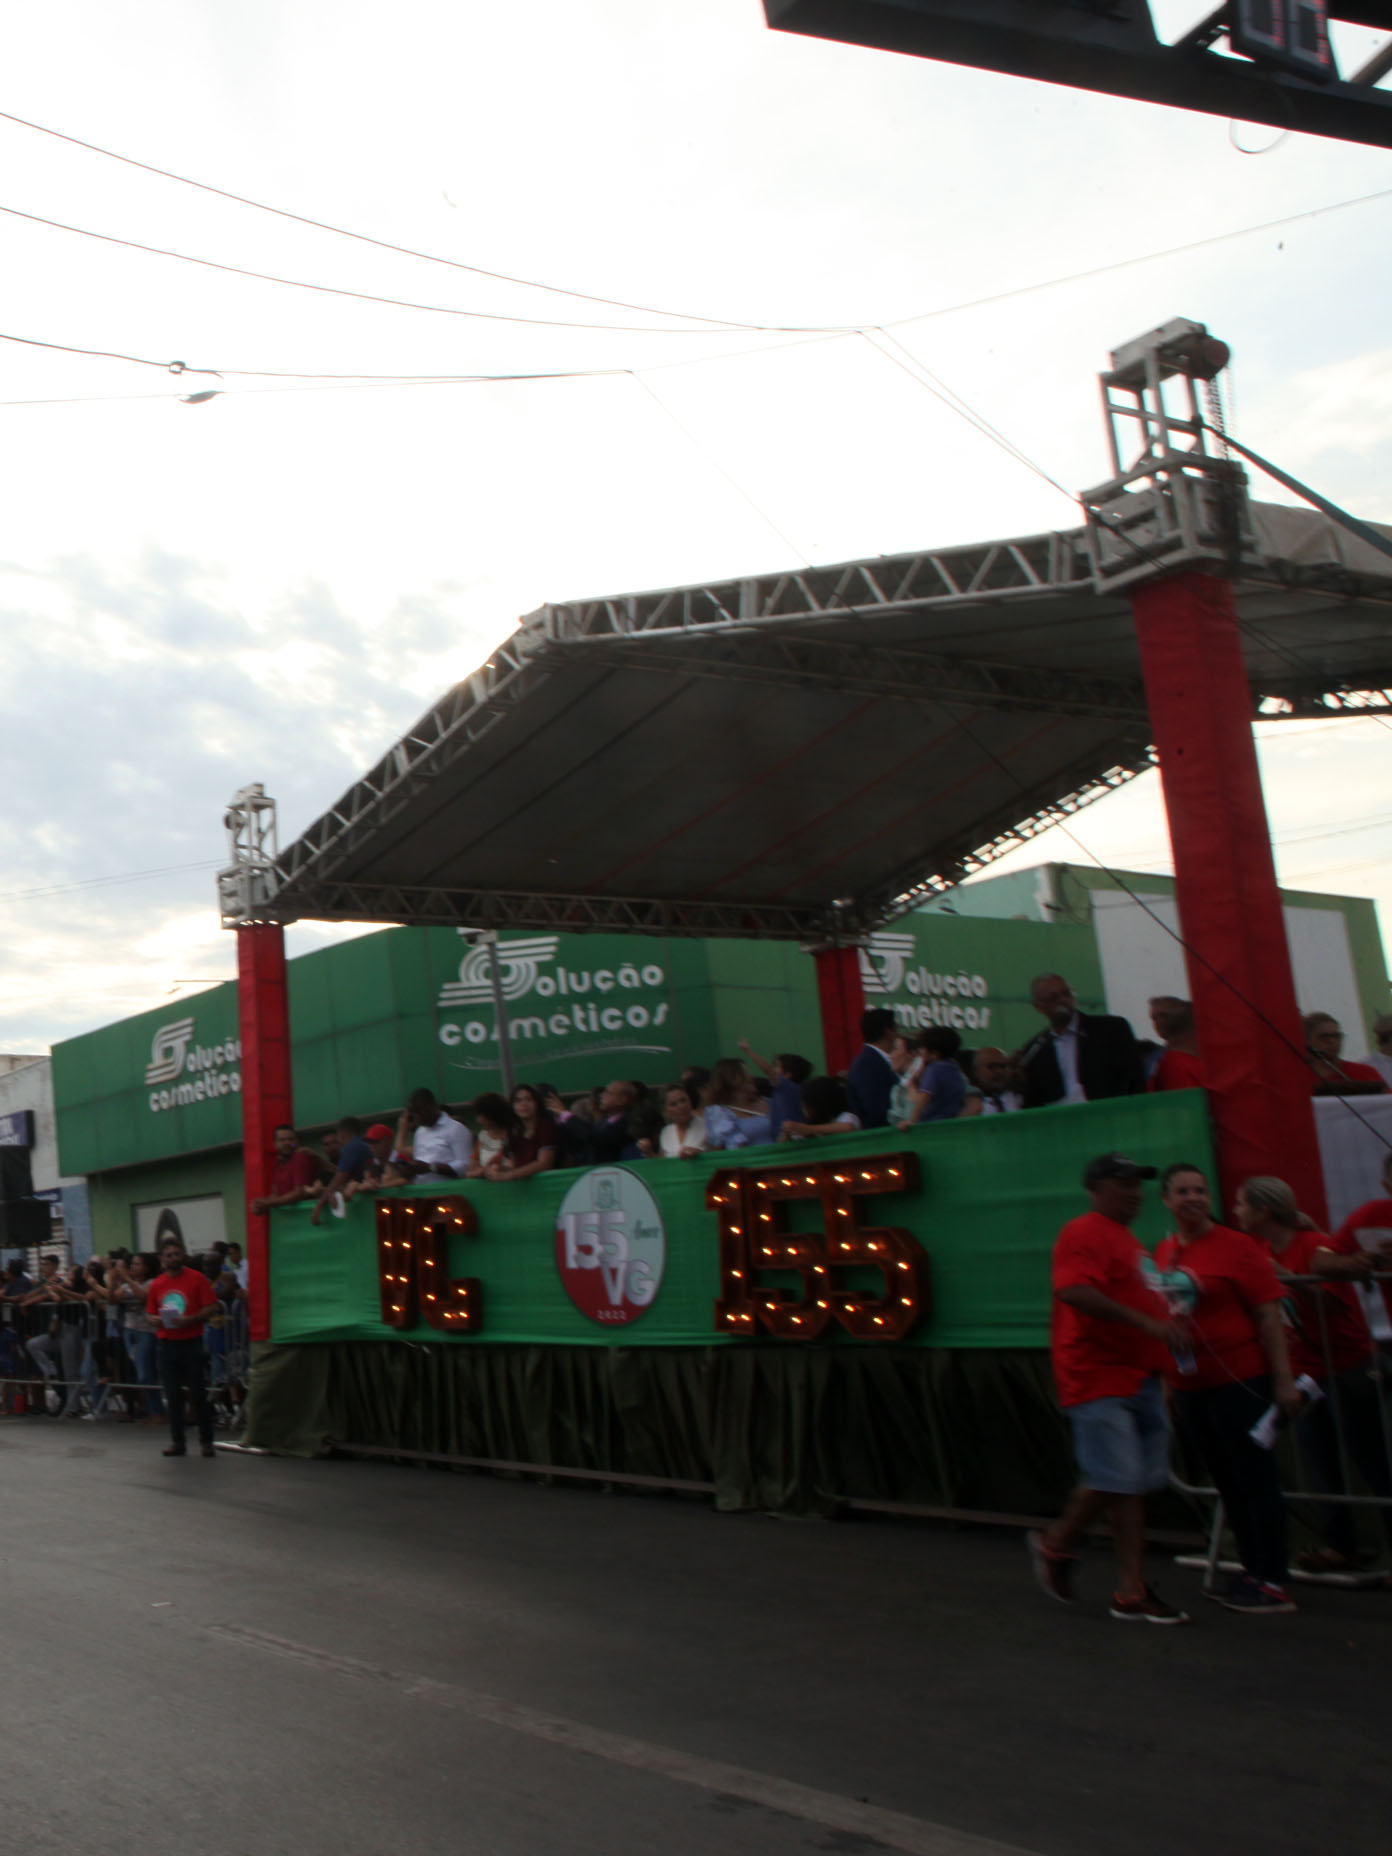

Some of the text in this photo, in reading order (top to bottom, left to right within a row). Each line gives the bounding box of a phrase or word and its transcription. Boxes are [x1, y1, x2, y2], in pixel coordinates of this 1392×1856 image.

[865, 999, 990, 1030] méticos
[557, 1210, 629, 1270] 155
[705, 1151, 930, 1342] 155
[599, 1261, 656, 1307] VG
